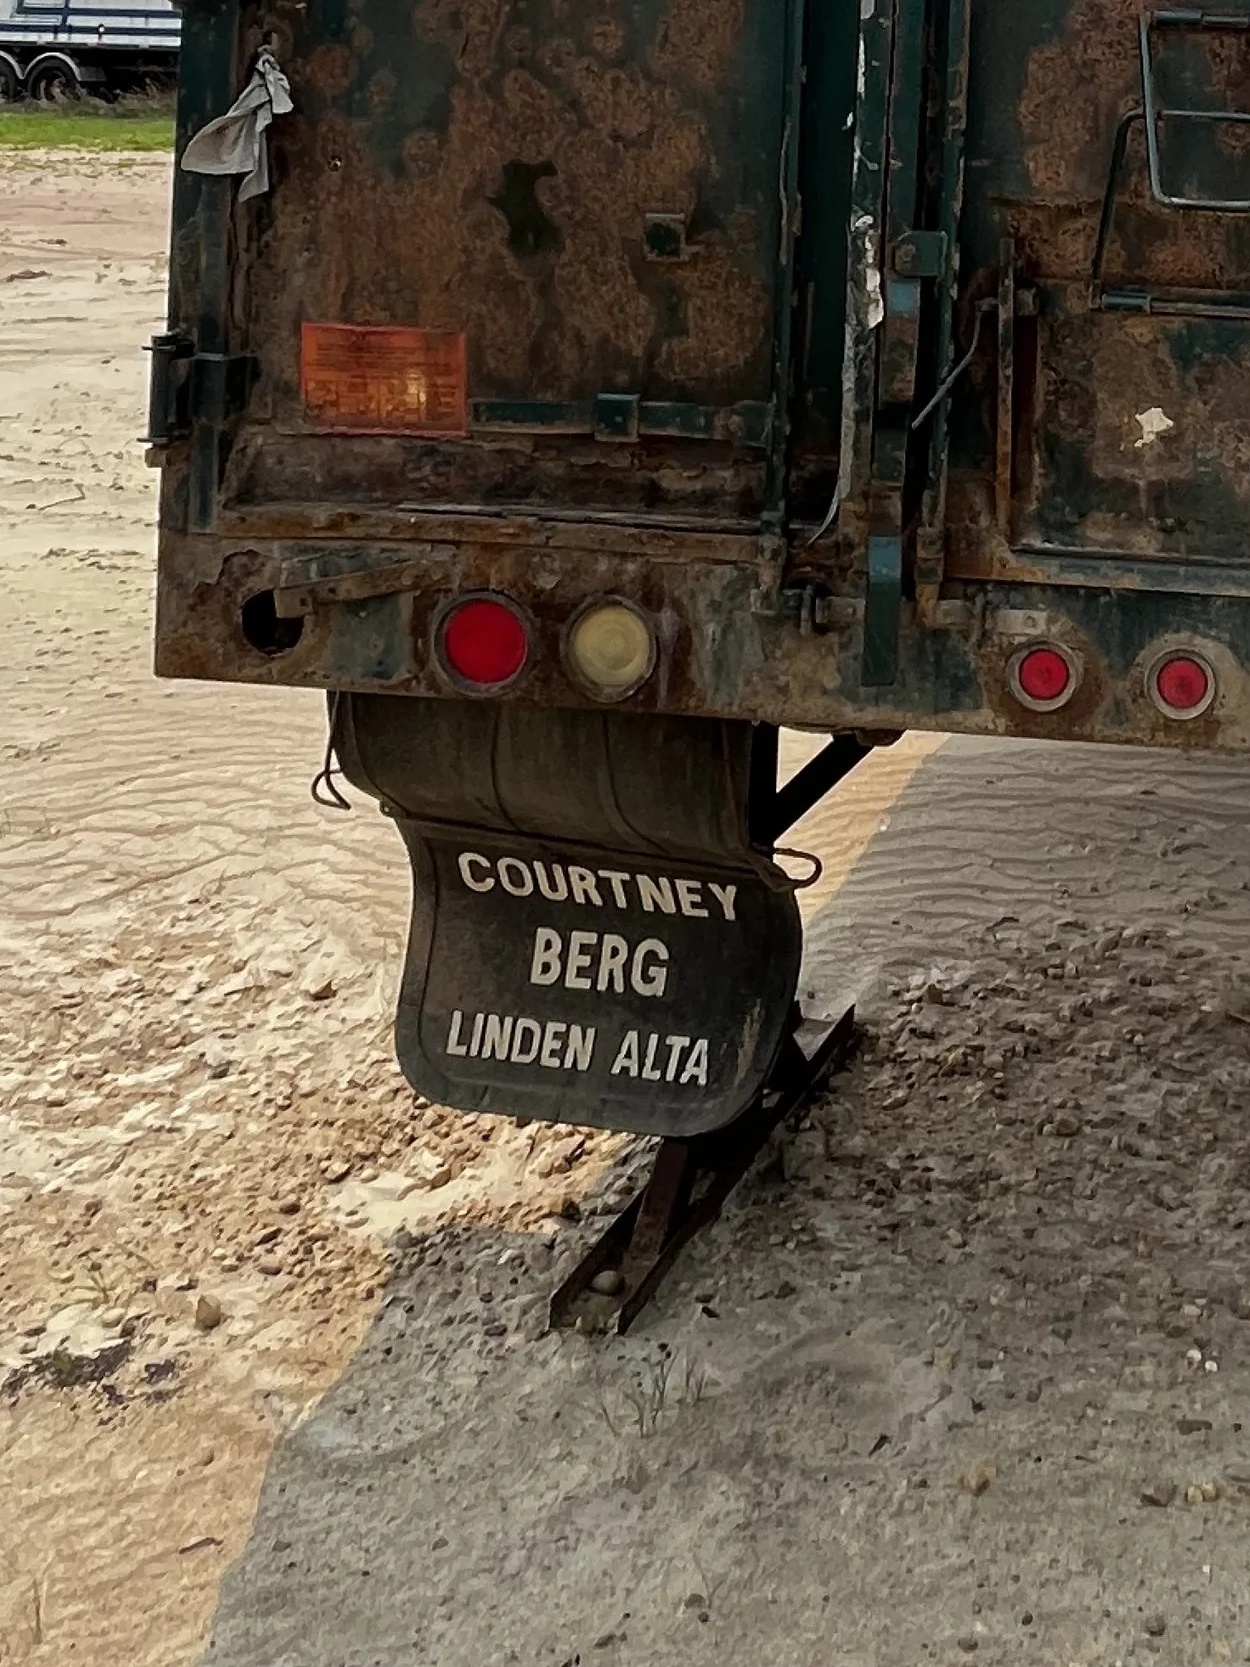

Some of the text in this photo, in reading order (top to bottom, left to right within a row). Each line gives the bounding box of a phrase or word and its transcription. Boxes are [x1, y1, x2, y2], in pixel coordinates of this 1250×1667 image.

[458, 851, 737, 922] COURTNEY
[530, 926, 670, 998] BERG
[446, 1009, 710, 1086] LINDEN ALTA
